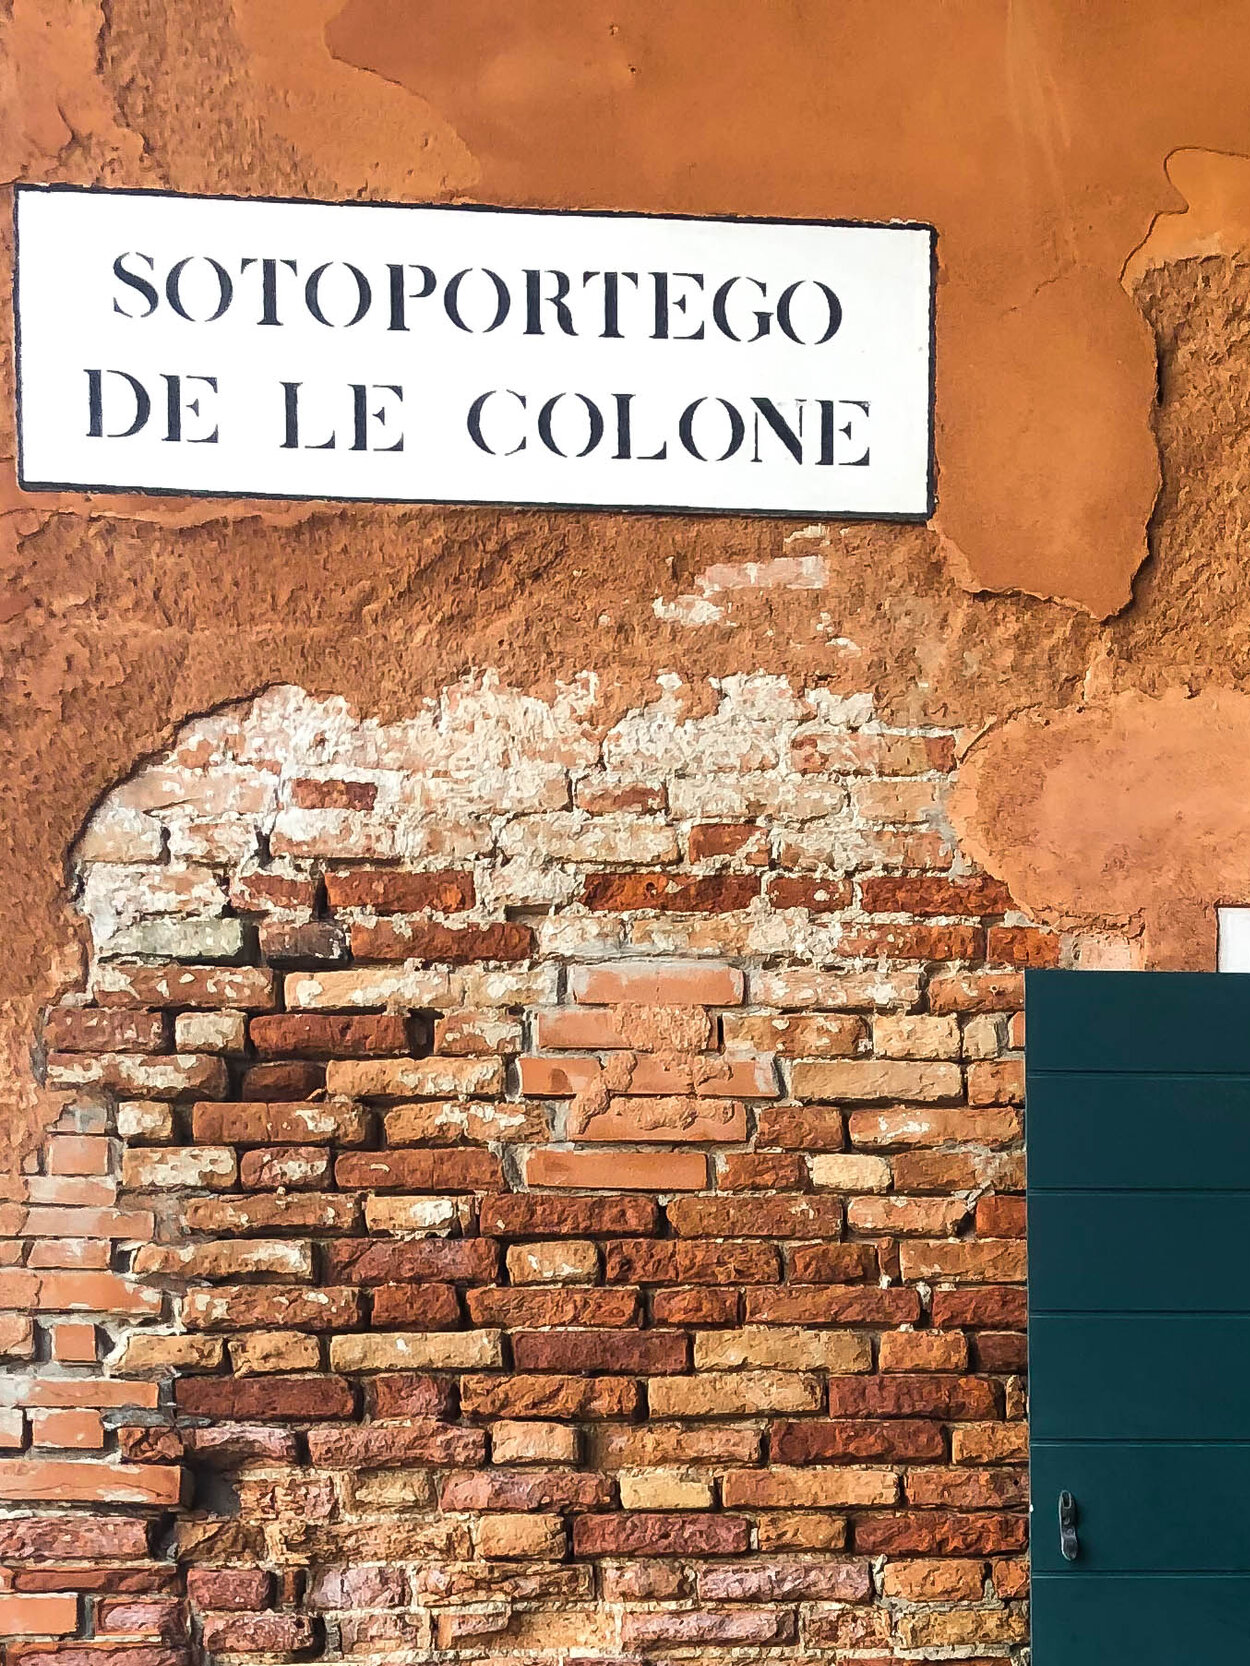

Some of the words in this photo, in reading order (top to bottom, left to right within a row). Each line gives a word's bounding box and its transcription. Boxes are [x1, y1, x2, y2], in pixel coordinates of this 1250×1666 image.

[112, 252, 843, 346] SOTOPORTEGO
[83, 369, 219, 444] DE
[279, 381, 404, 452] LE
[466, 389, 871, 467] COLONE
